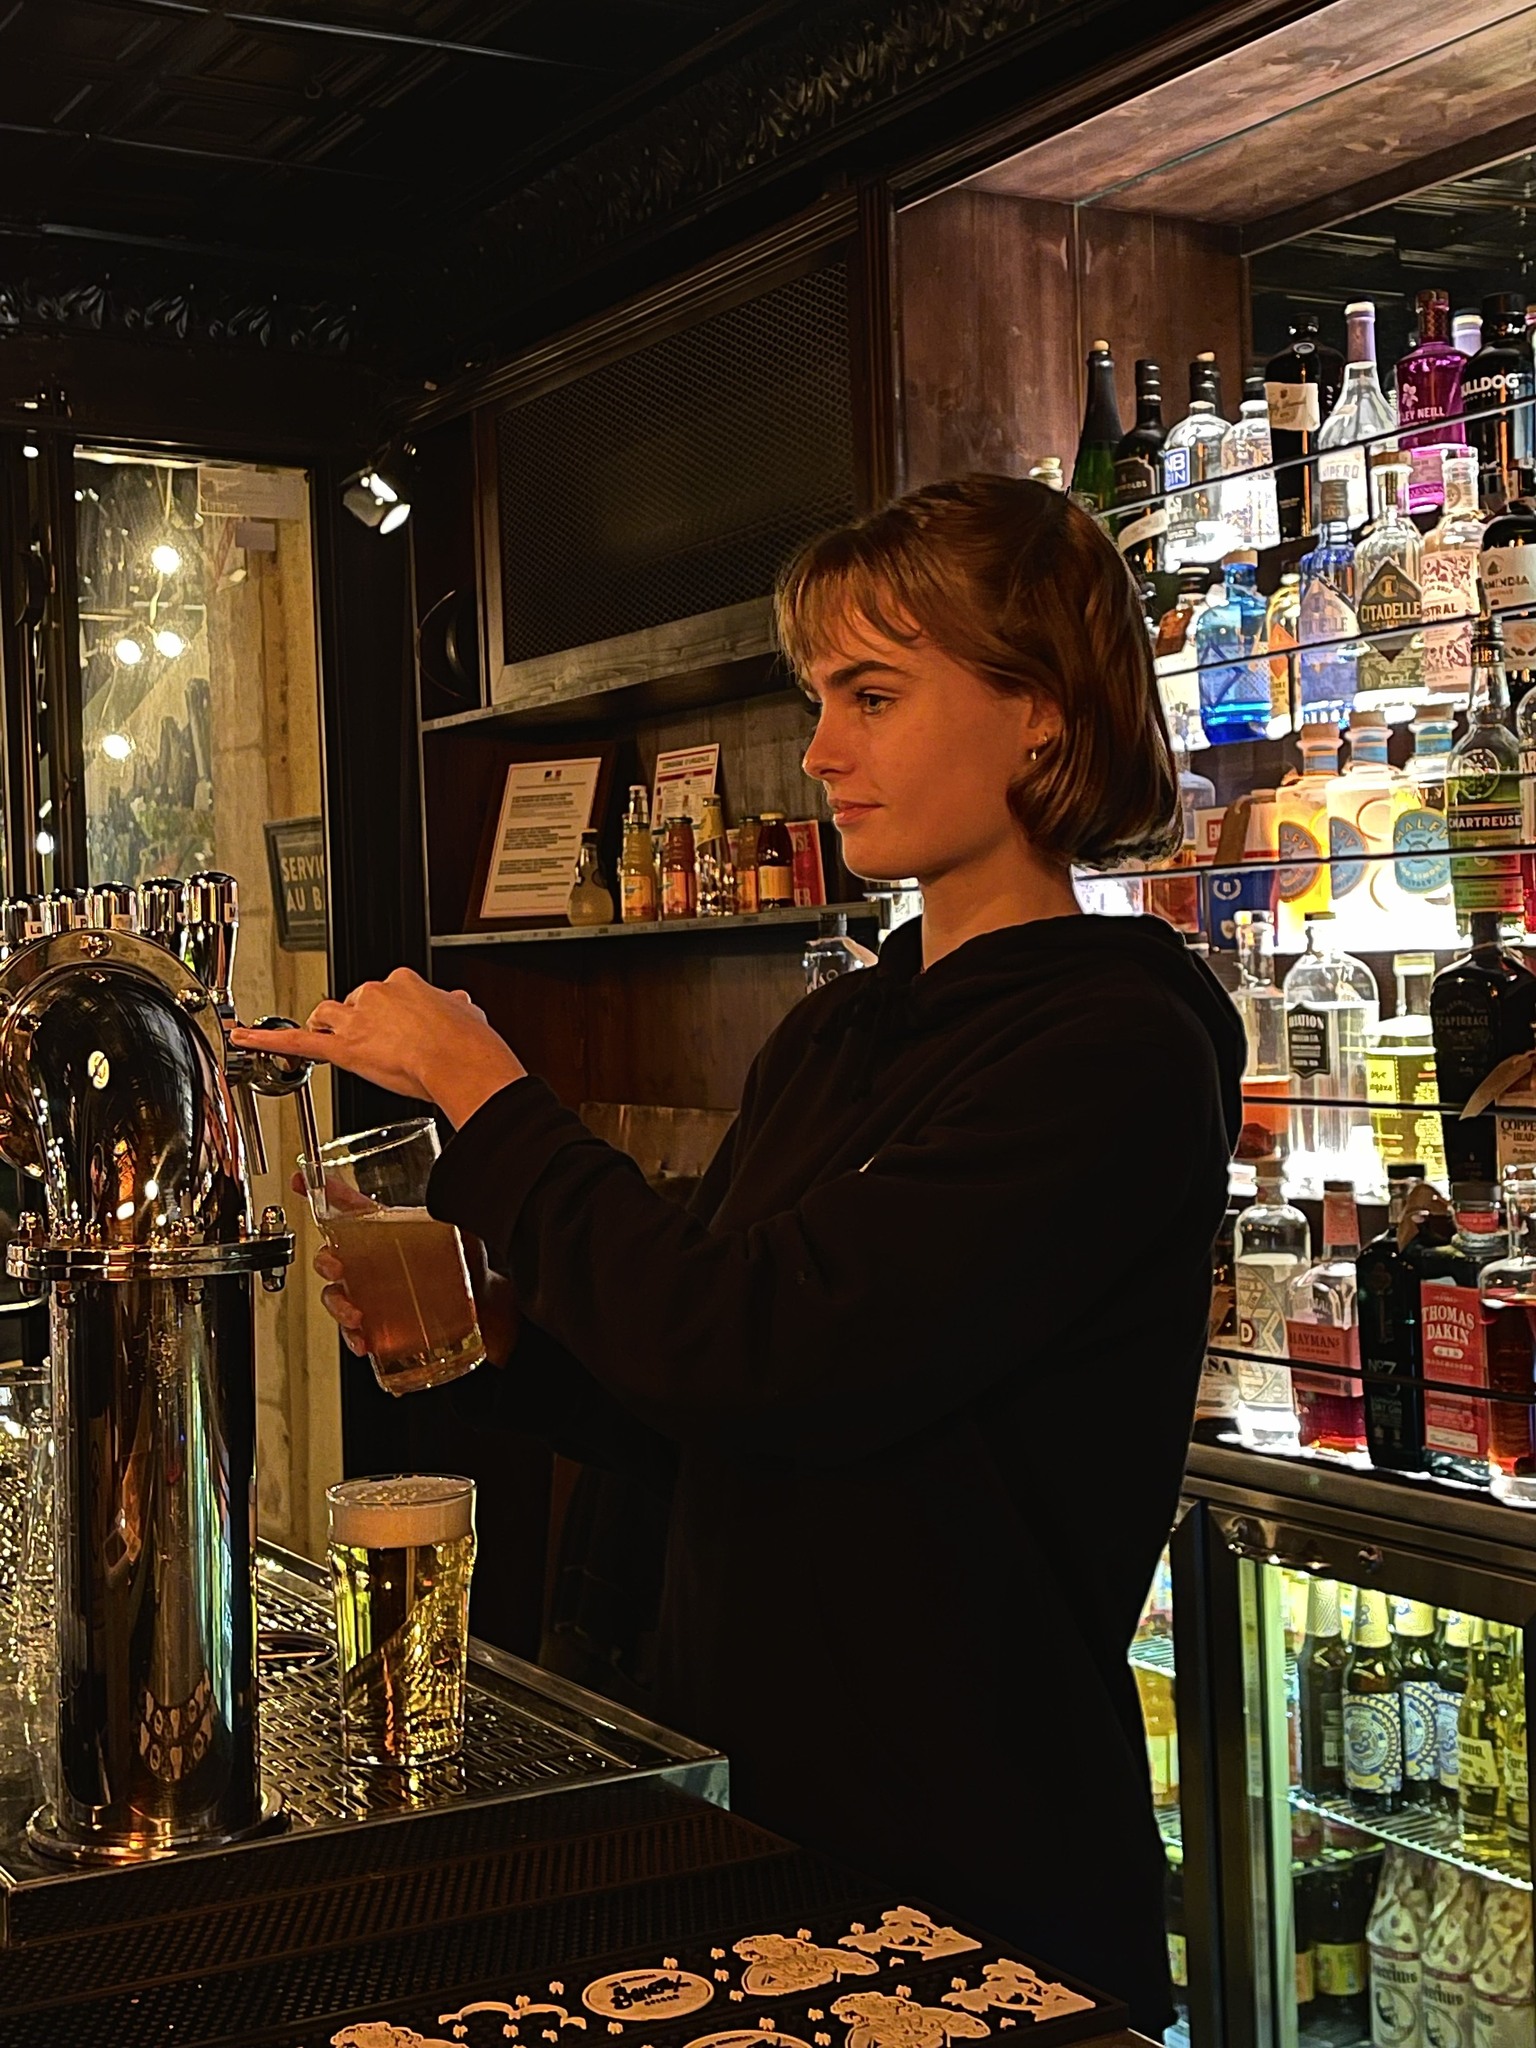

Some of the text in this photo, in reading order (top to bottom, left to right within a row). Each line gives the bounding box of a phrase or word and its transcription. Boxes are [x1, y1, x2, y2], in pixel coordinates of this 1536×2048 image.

[1417, 406, 1446, 418] NEILL
[1361, 601, 1421, 624] CITADELLE
[1448, 813, 1522, 830] CHARTREUSE
[287, 885, 326, 913] AU B
[1421, 1304, 1475, 1330] THOMAS
[1426, 1322, 1470, 1346] DAKIN
